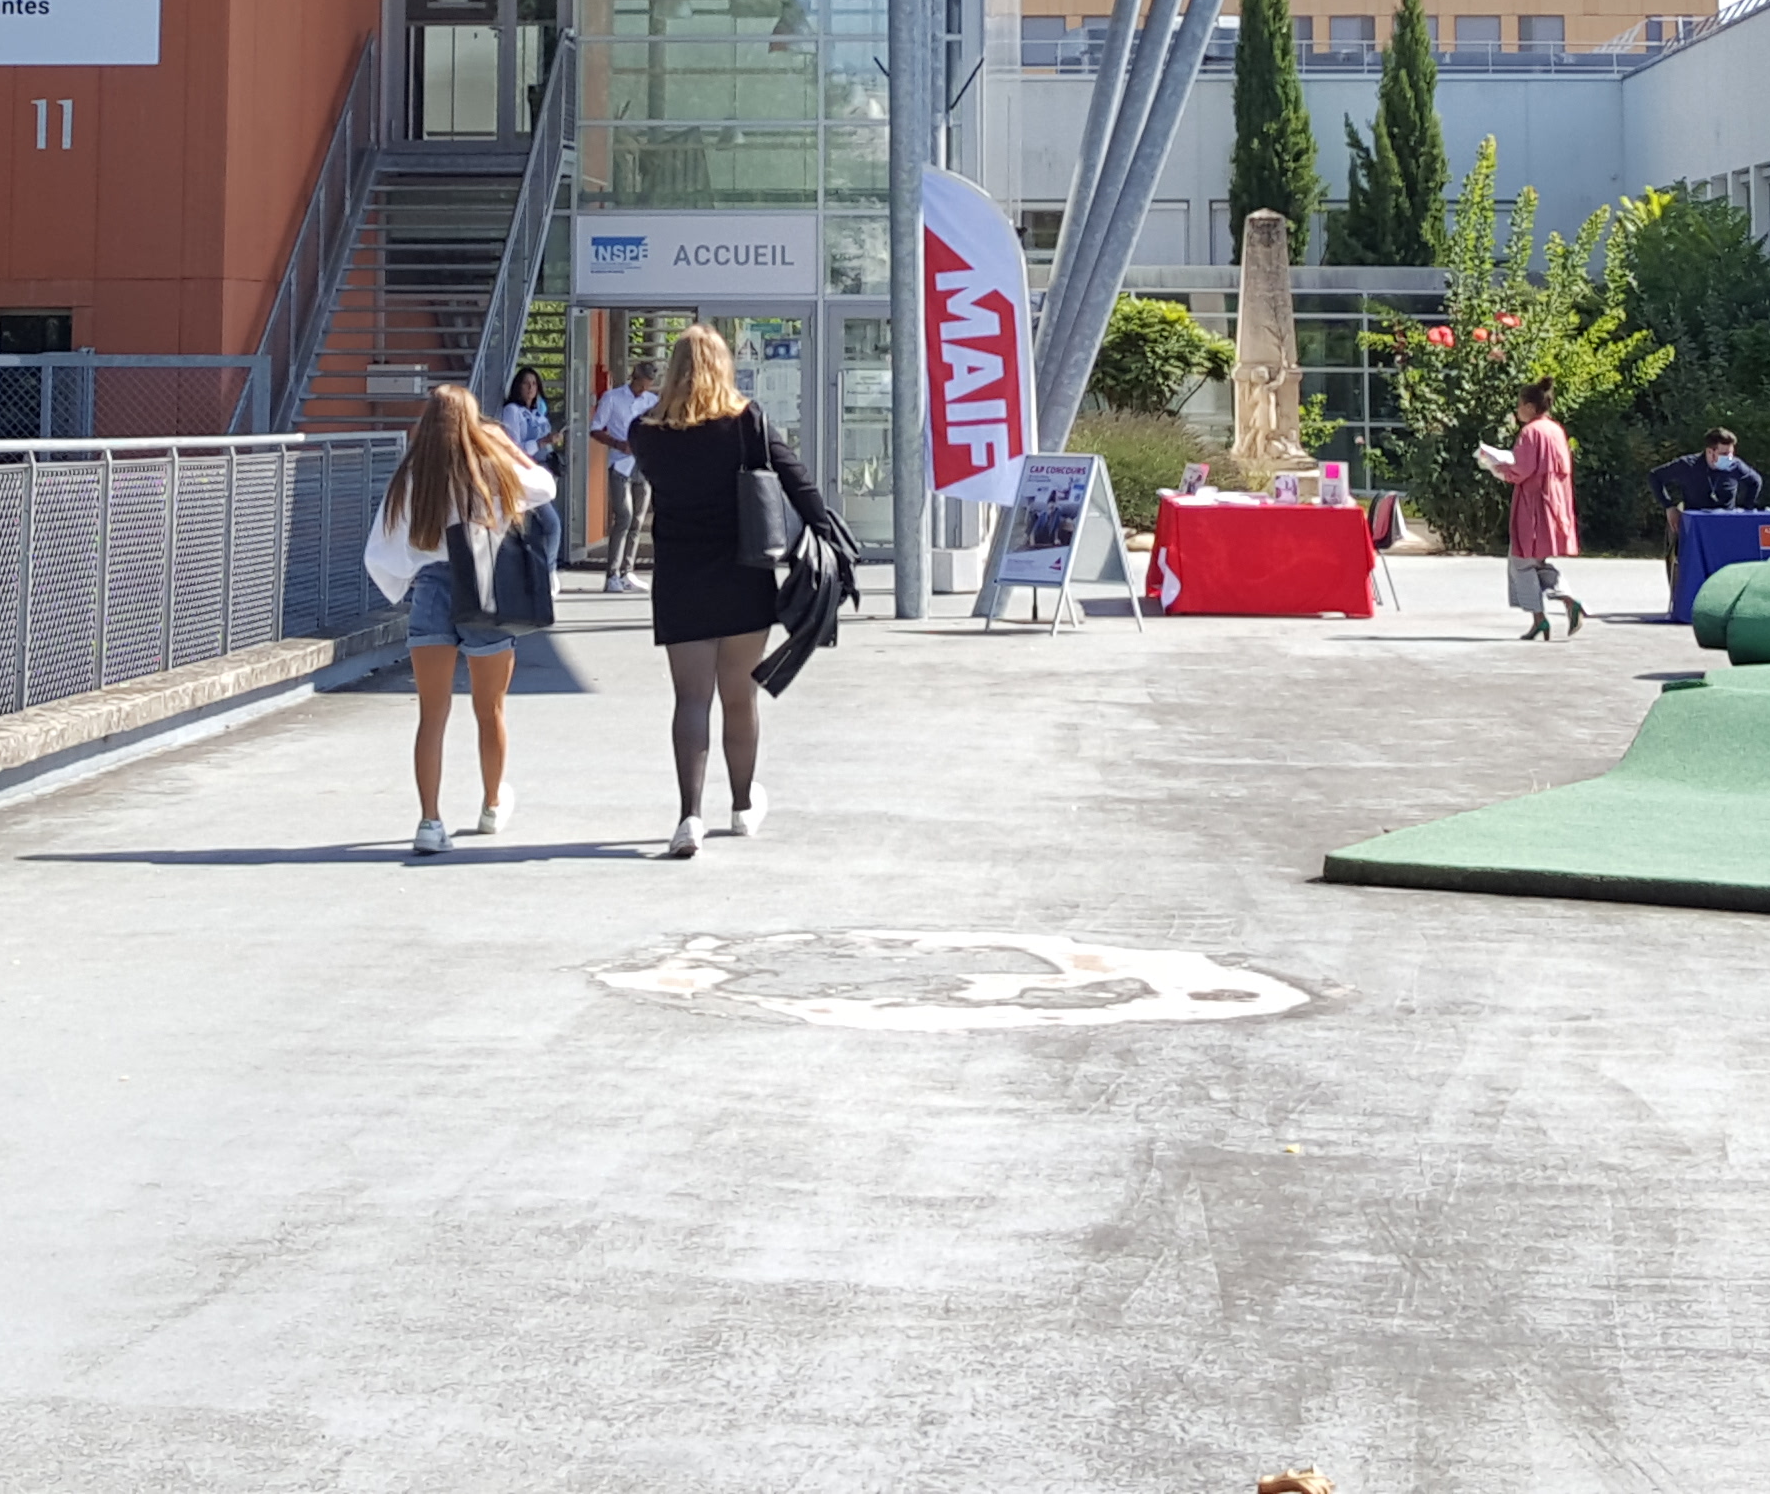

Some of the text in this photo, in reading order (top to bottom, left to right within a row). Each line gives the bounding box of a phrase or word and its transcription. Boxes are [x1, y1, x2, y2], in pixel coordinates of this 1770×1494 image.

[30, 98, 73, 150] 11
[672, 244, 795, 266] ACCUEIL
[935, 270, 1009, 468] MAIF
